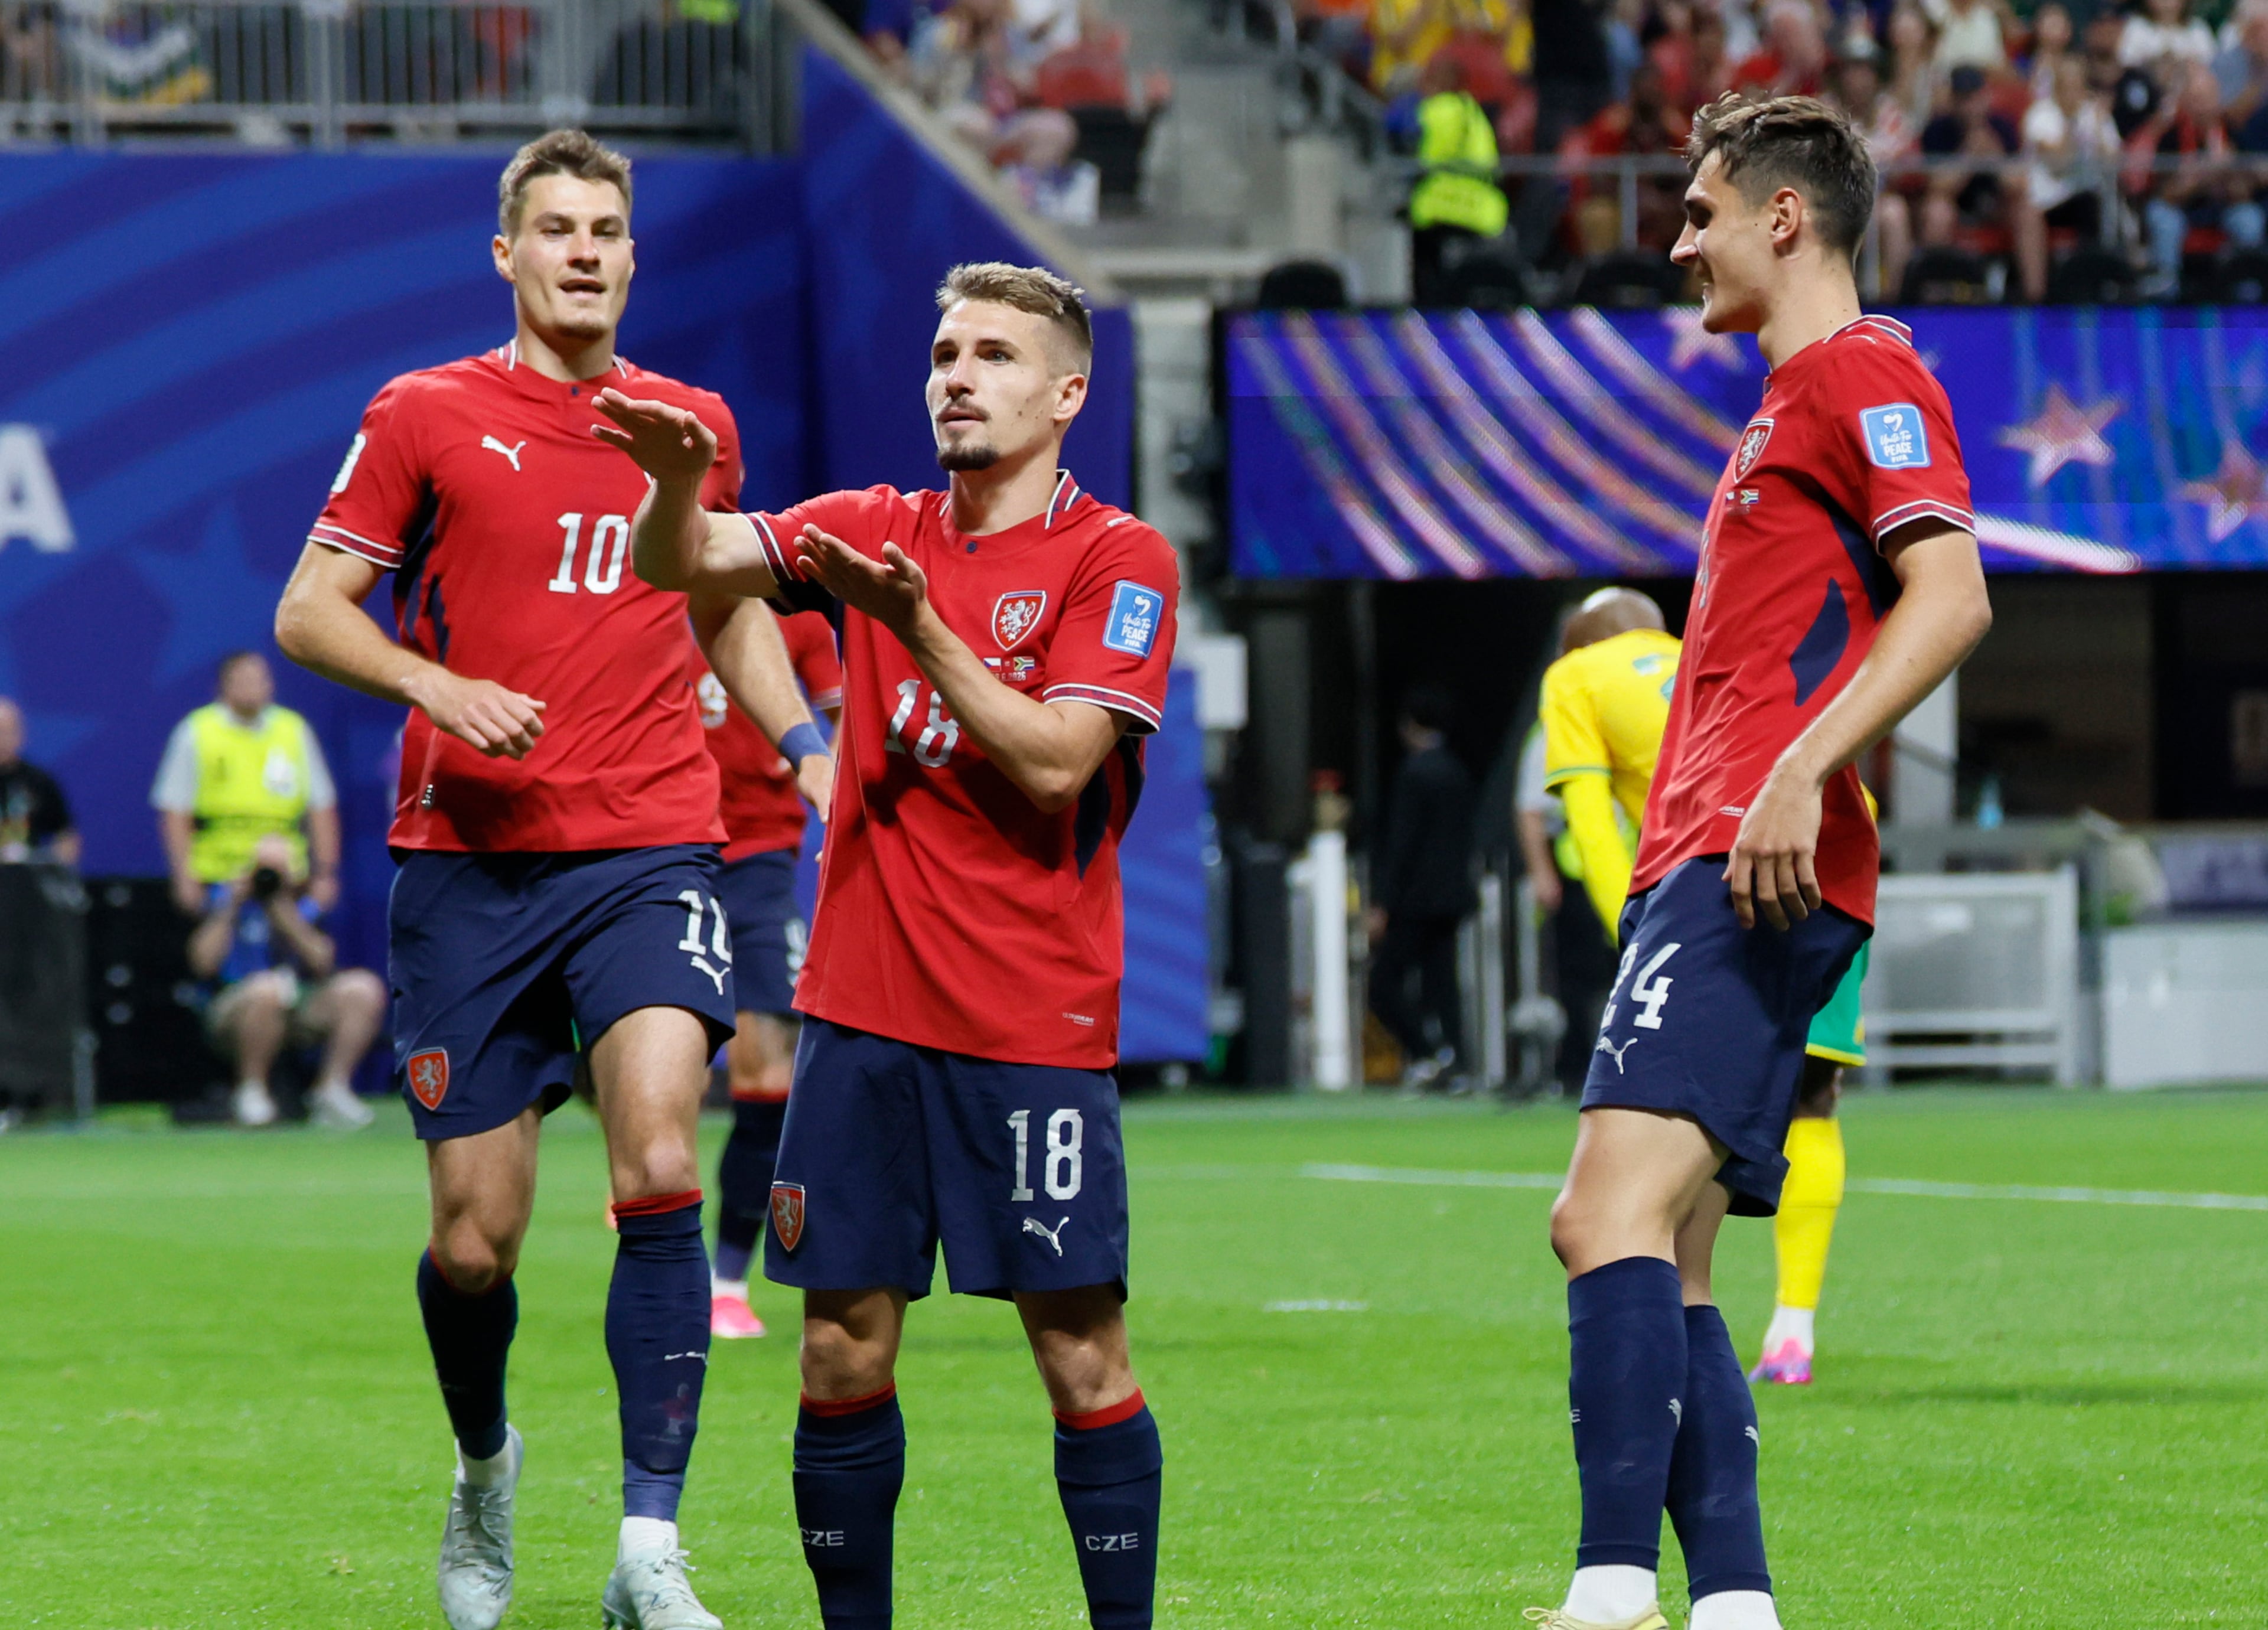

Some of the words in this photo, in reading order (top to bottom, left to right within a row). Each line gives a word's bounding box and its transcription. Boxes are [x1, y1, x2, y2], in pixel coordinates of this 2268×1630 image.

[0, 423, 77, 553] A
[1884, 442, 1913, 457] PEACE
[548, 511, 630, 595] 10
[1121, 624, 1149, 643] PEACE
[884, 678, 959, 768] 18
[1600, 942, 1682, 1030] 24
[1006, 1108, 1084, 1202] 18
[1085, 1532, 1139, 1552] CZE
